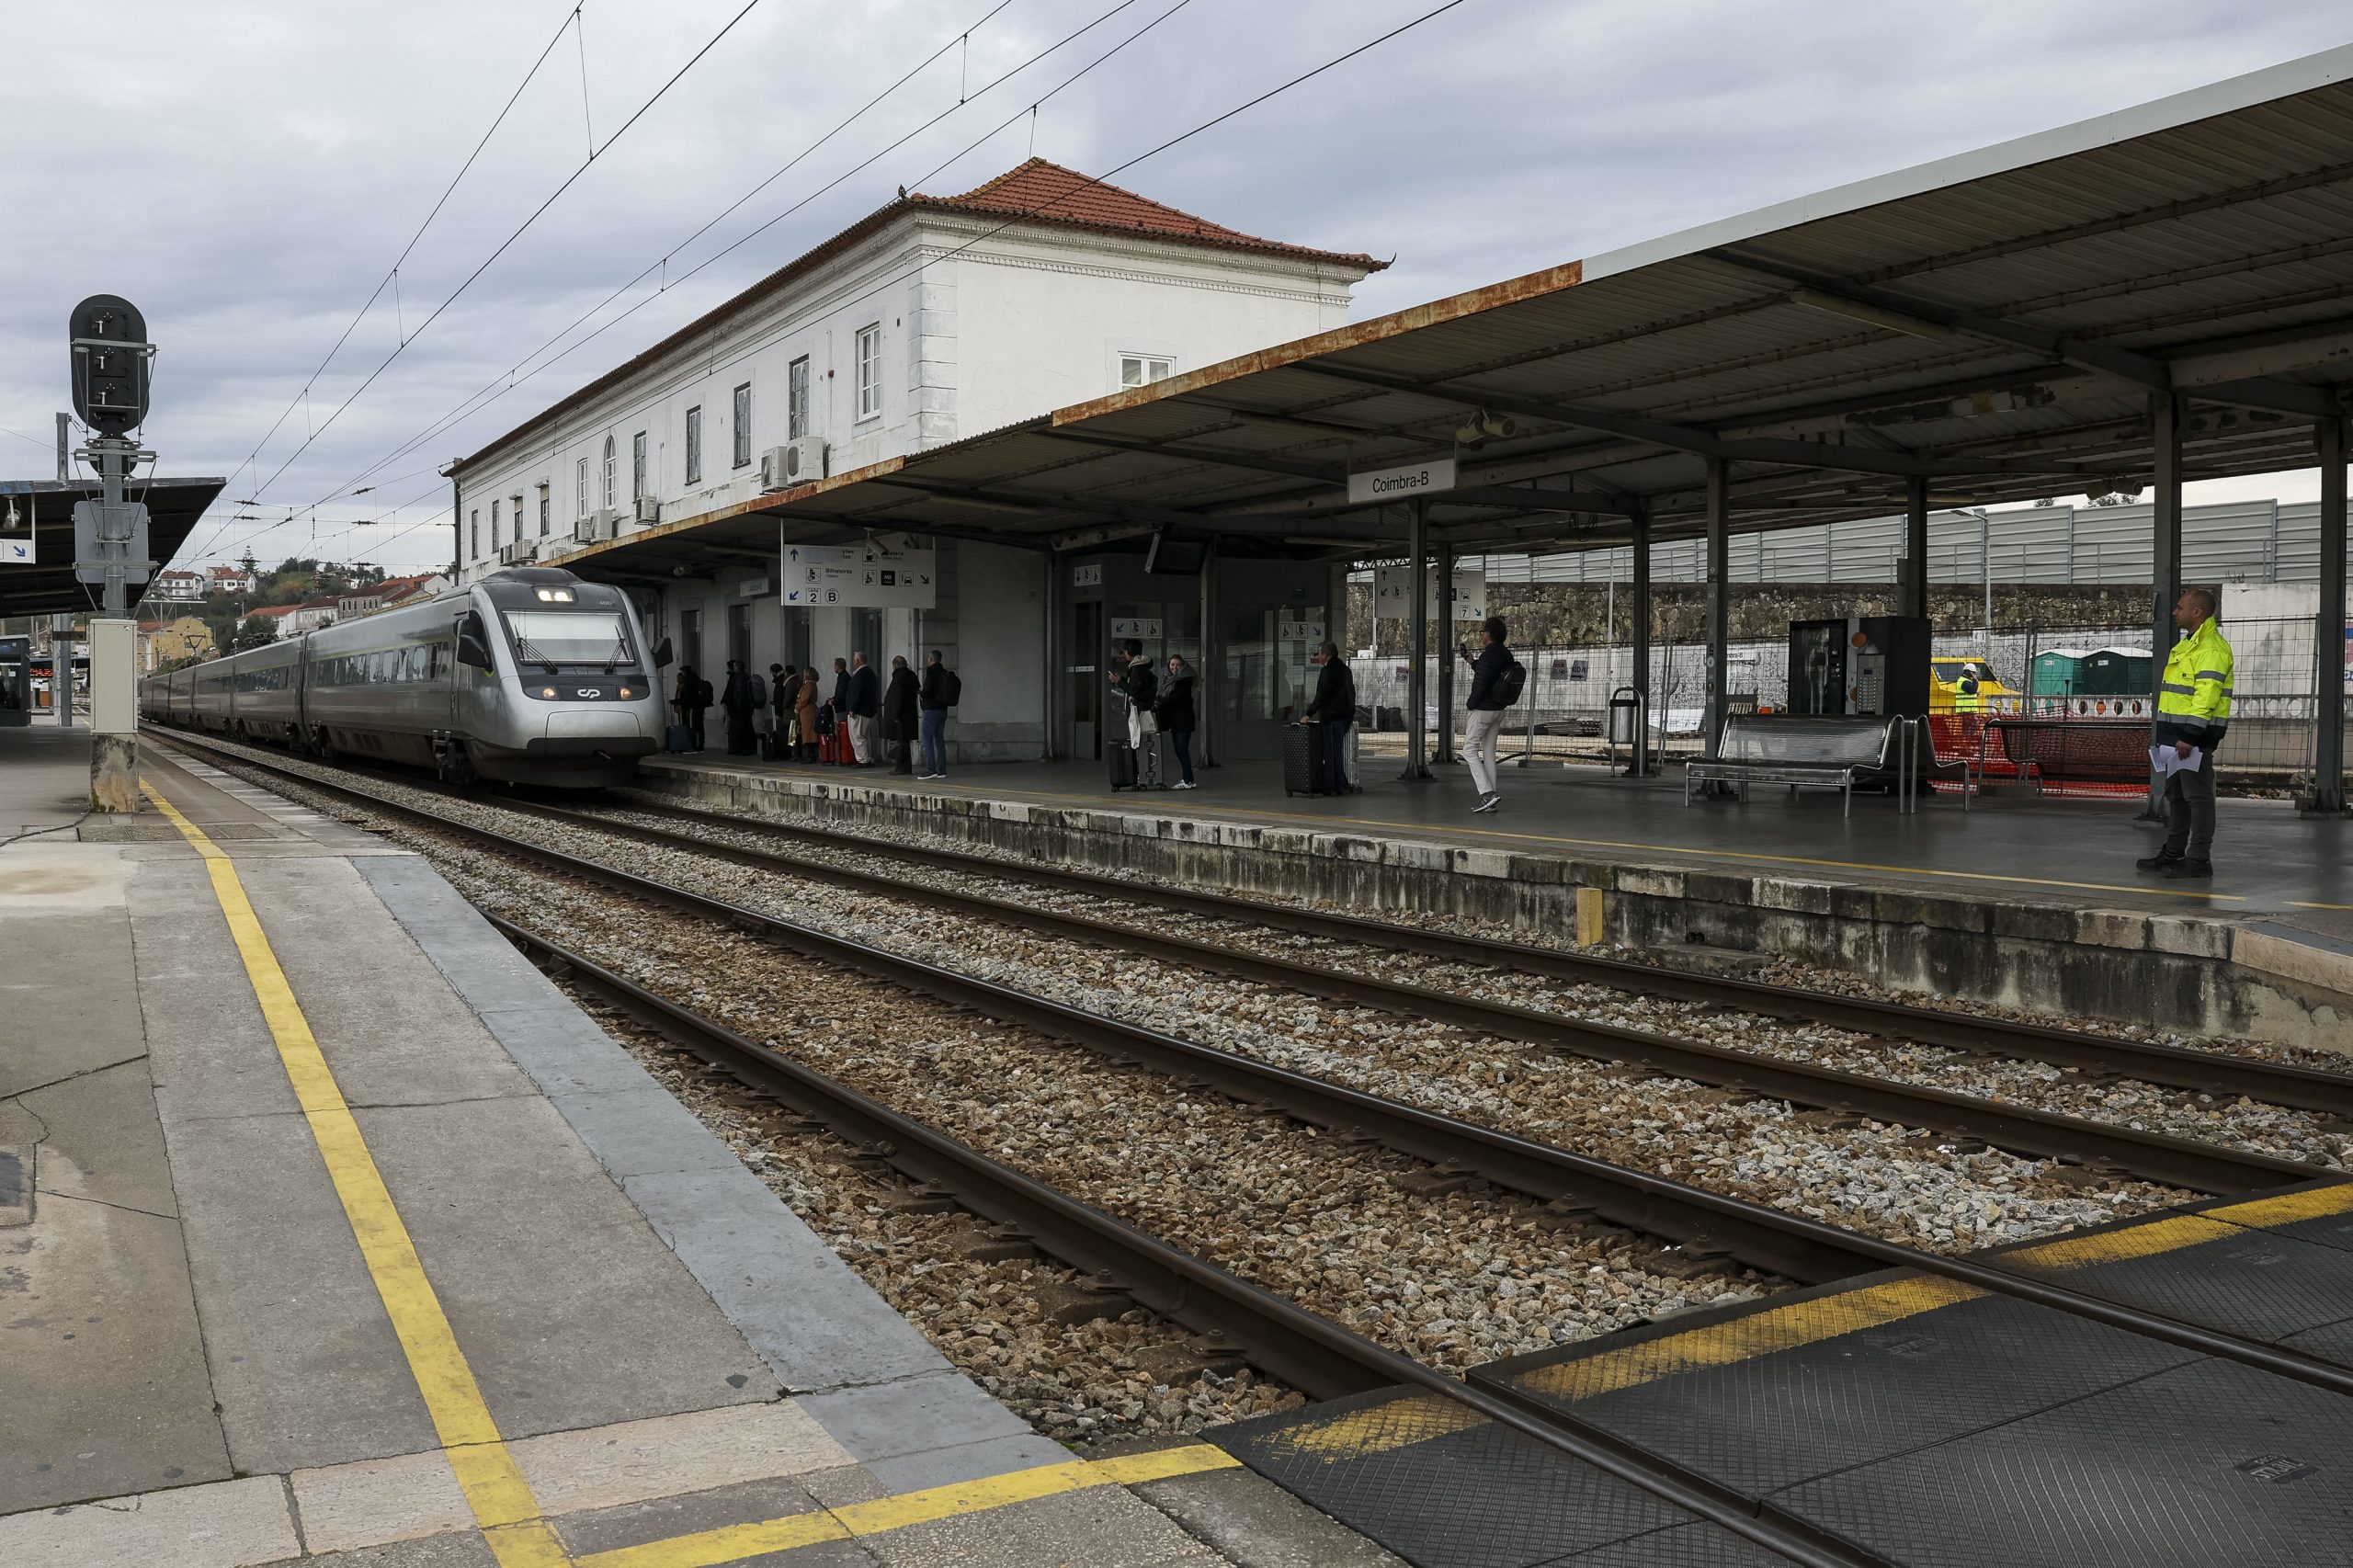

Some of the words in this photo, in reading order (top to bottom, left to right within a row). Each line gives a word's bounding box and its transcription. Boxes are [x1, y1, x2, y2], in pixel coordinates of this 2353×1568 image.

[1372, 471, 1429, 494] Coimbra-B
[810, 593, 817, 603] 2
[828, 592, 836, 602] B
[1461, 609, 1467, 618] 7
[576, 688, 601, 699] CP
